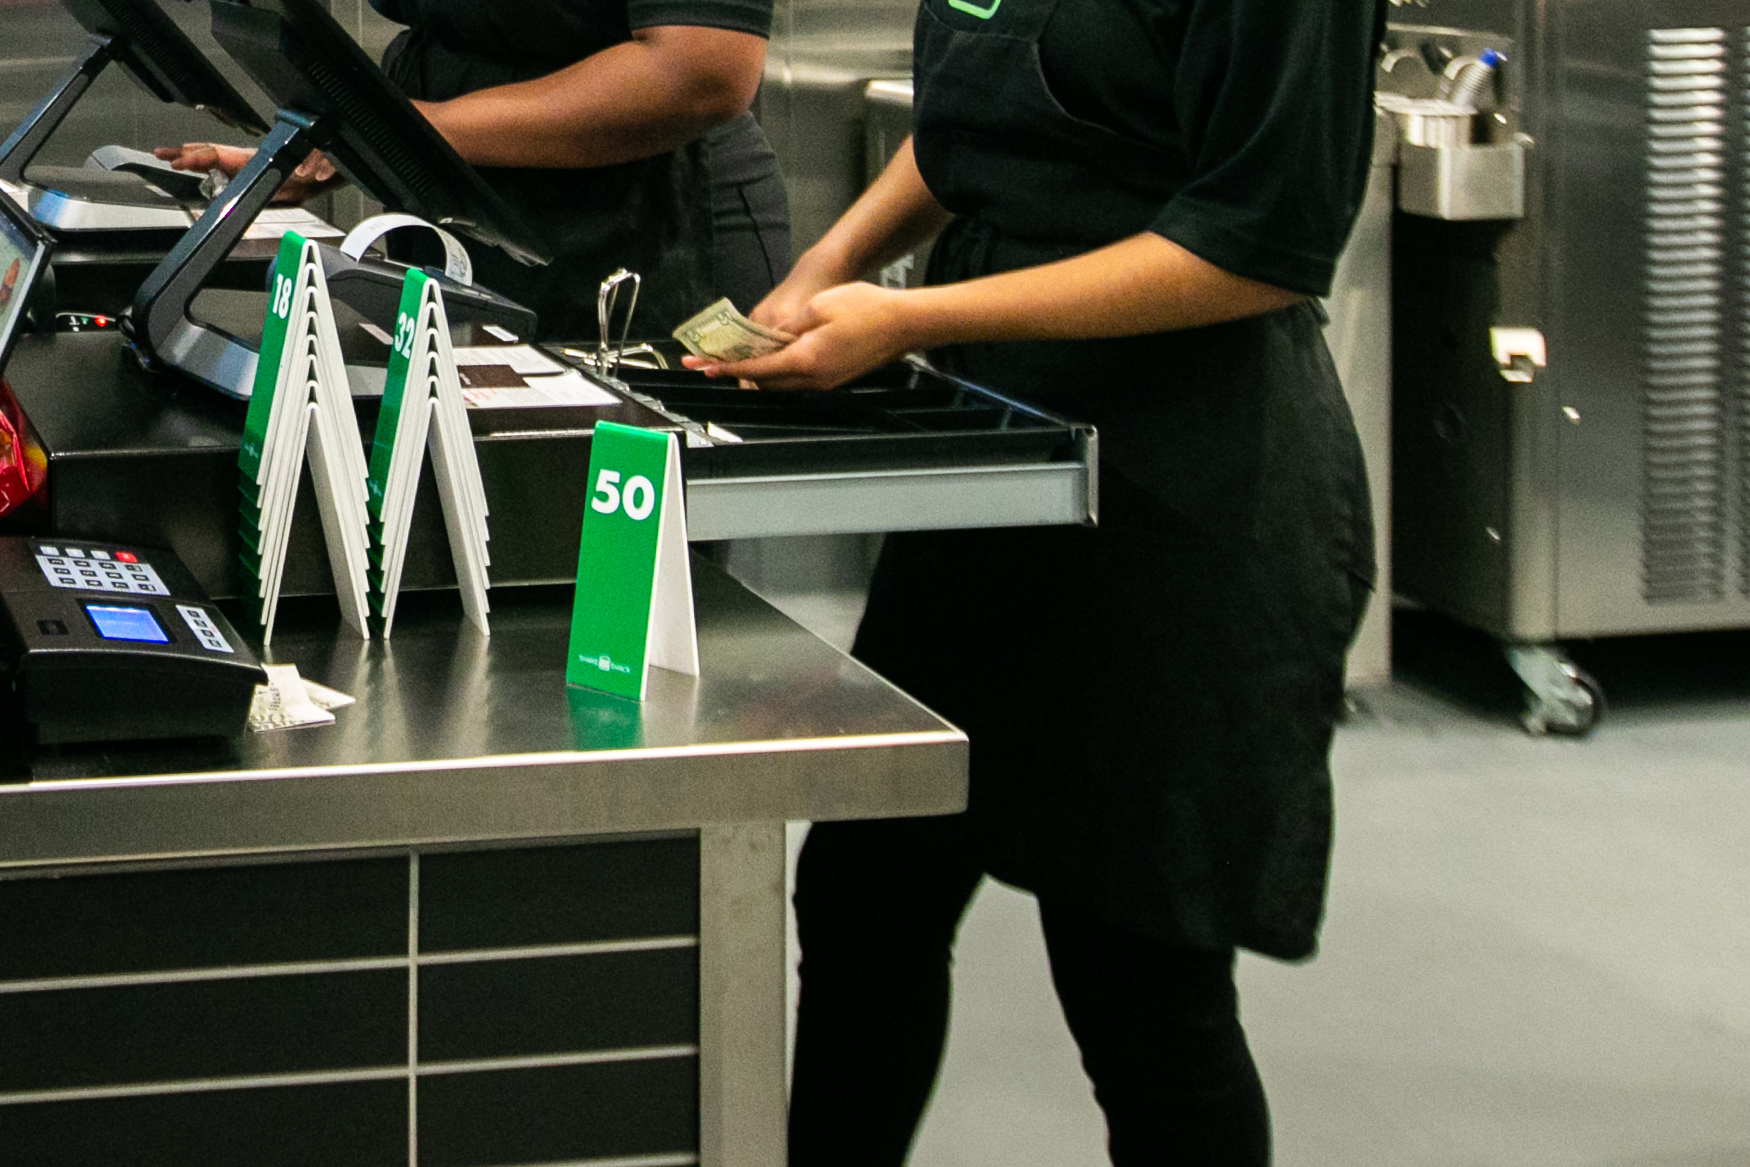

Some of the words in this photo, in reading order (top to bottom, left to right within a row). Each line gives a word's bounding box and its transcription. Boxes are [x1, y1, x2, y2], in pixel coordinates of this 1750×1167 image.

[272, 273, 293, 320] 18
[394, 311, 416, 360] 32
[590, 468, 656, 522] 50
